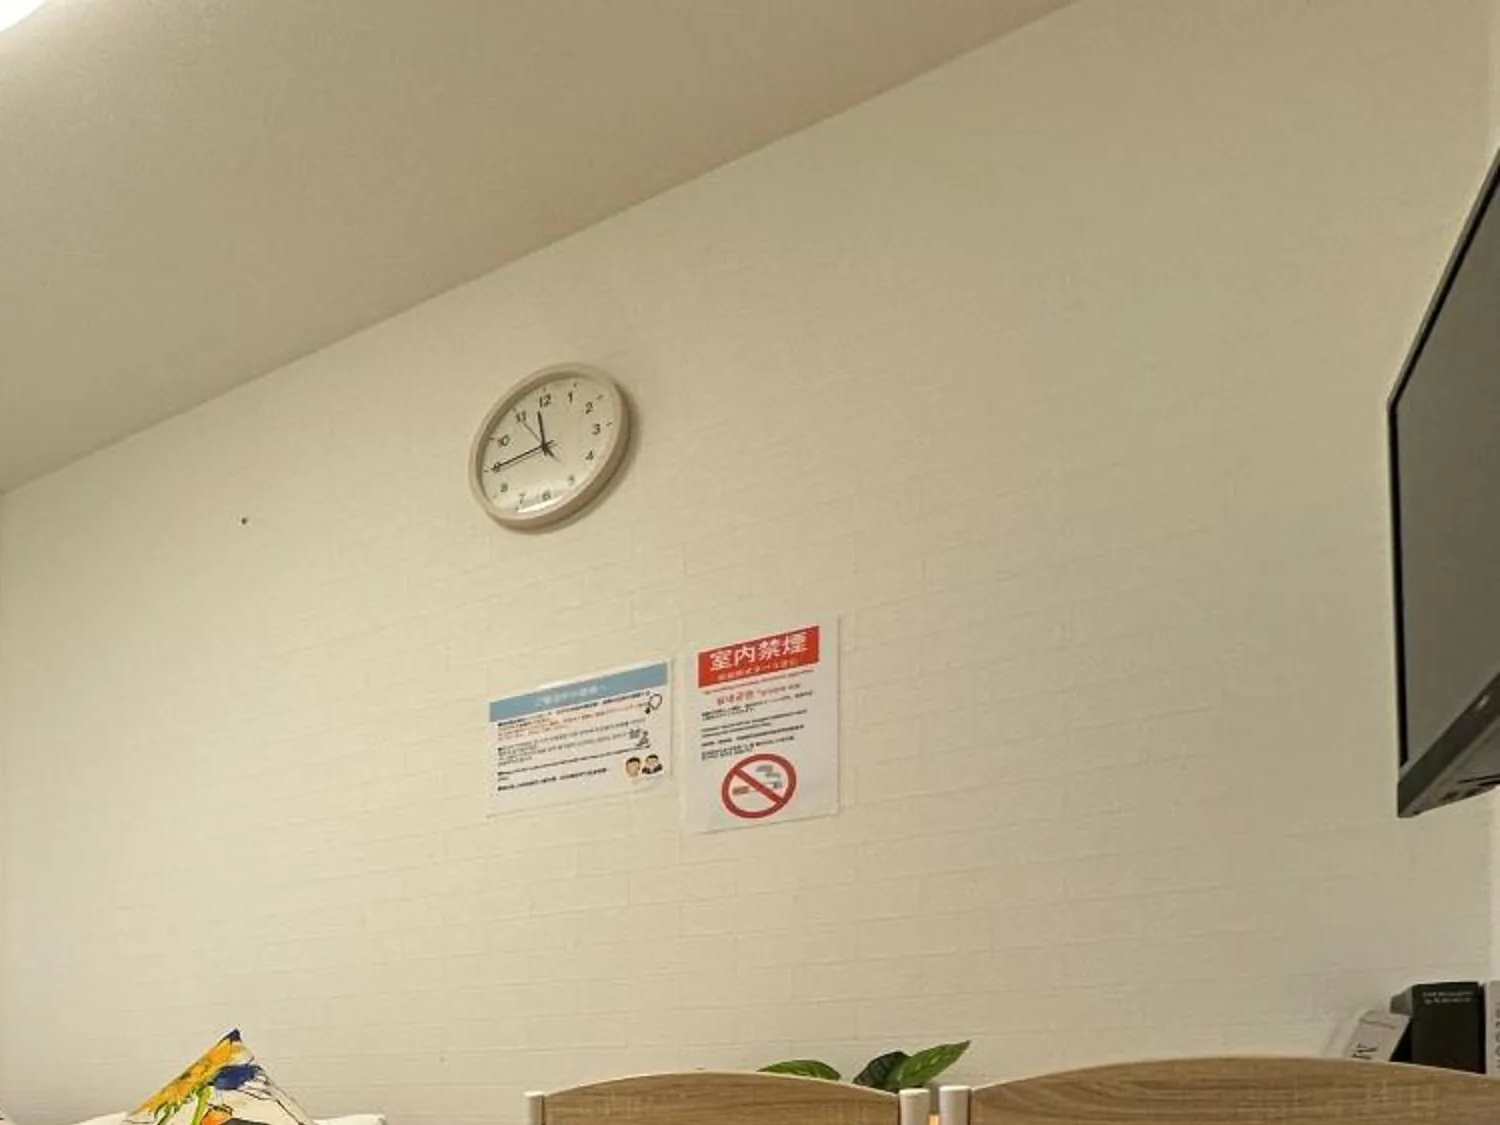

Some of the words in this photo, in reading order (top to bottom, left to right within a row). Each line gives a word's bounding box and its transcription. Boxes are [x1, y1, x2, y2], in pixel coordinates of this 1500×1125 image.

[540, 393, 552, 408] 12
[567, 391, 573, 404] 1
[584, 401, 594, 415] 2
[515, 411, 527, 423] 11
[592, 423, 601, 436] 3
[498, 434, 510, 447] 10
[585, 450, 594, 461] 4
[709, 632, 808, 671] 室内禁煙
